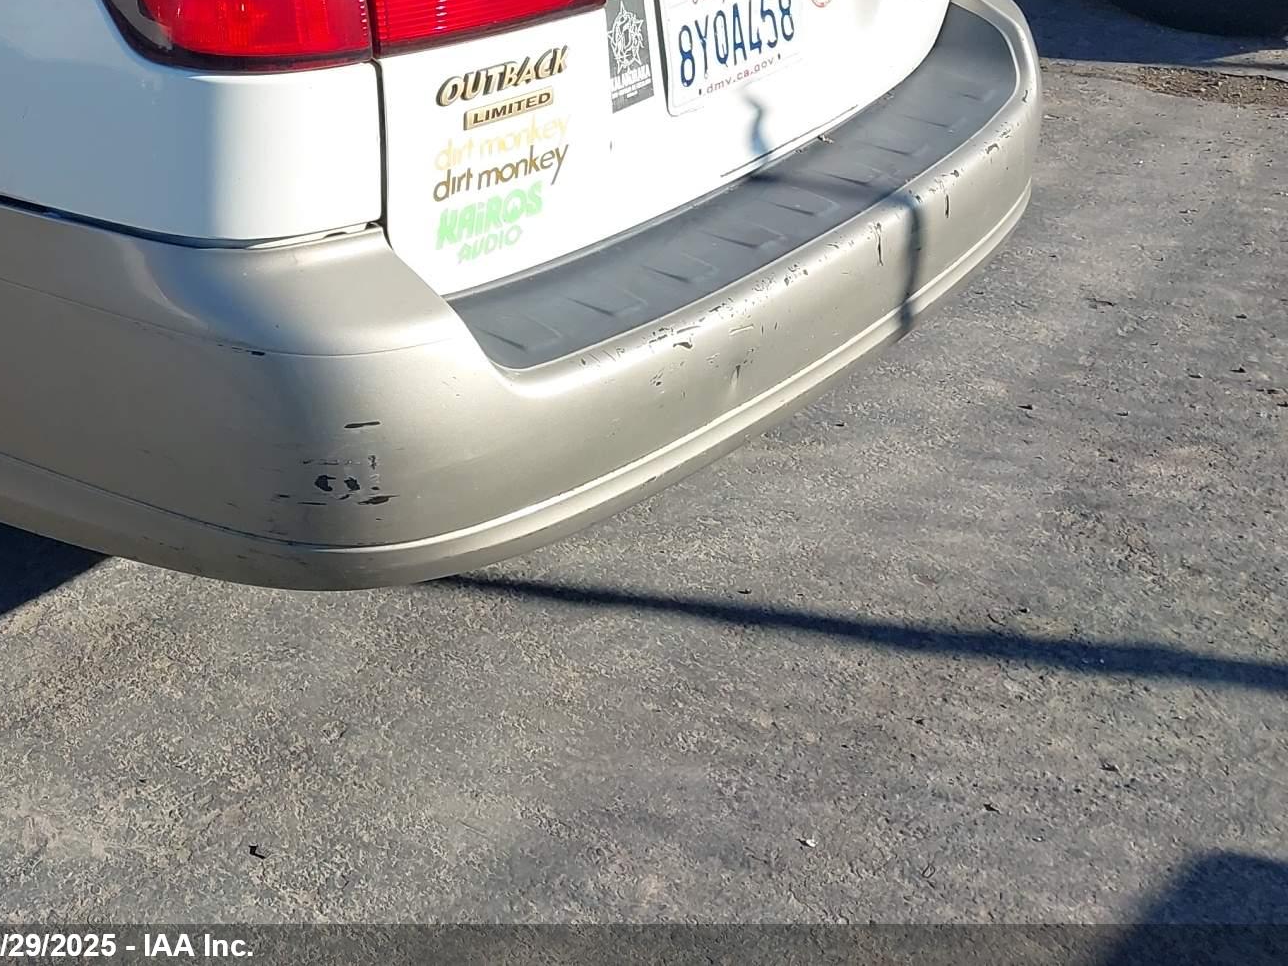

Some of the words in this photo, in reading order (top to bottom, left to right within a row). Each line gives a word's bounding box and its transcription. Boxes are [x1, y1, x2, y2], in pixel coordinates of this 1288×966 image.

[436, 45, 569, 107] OUTBACK
[706, 56, 776, 95] dmv.ca.gov
[473, 92, 551, 124] LIMITED
[433, 168, 473, 202] dirt
[477, 144, 569, 191] monkey
